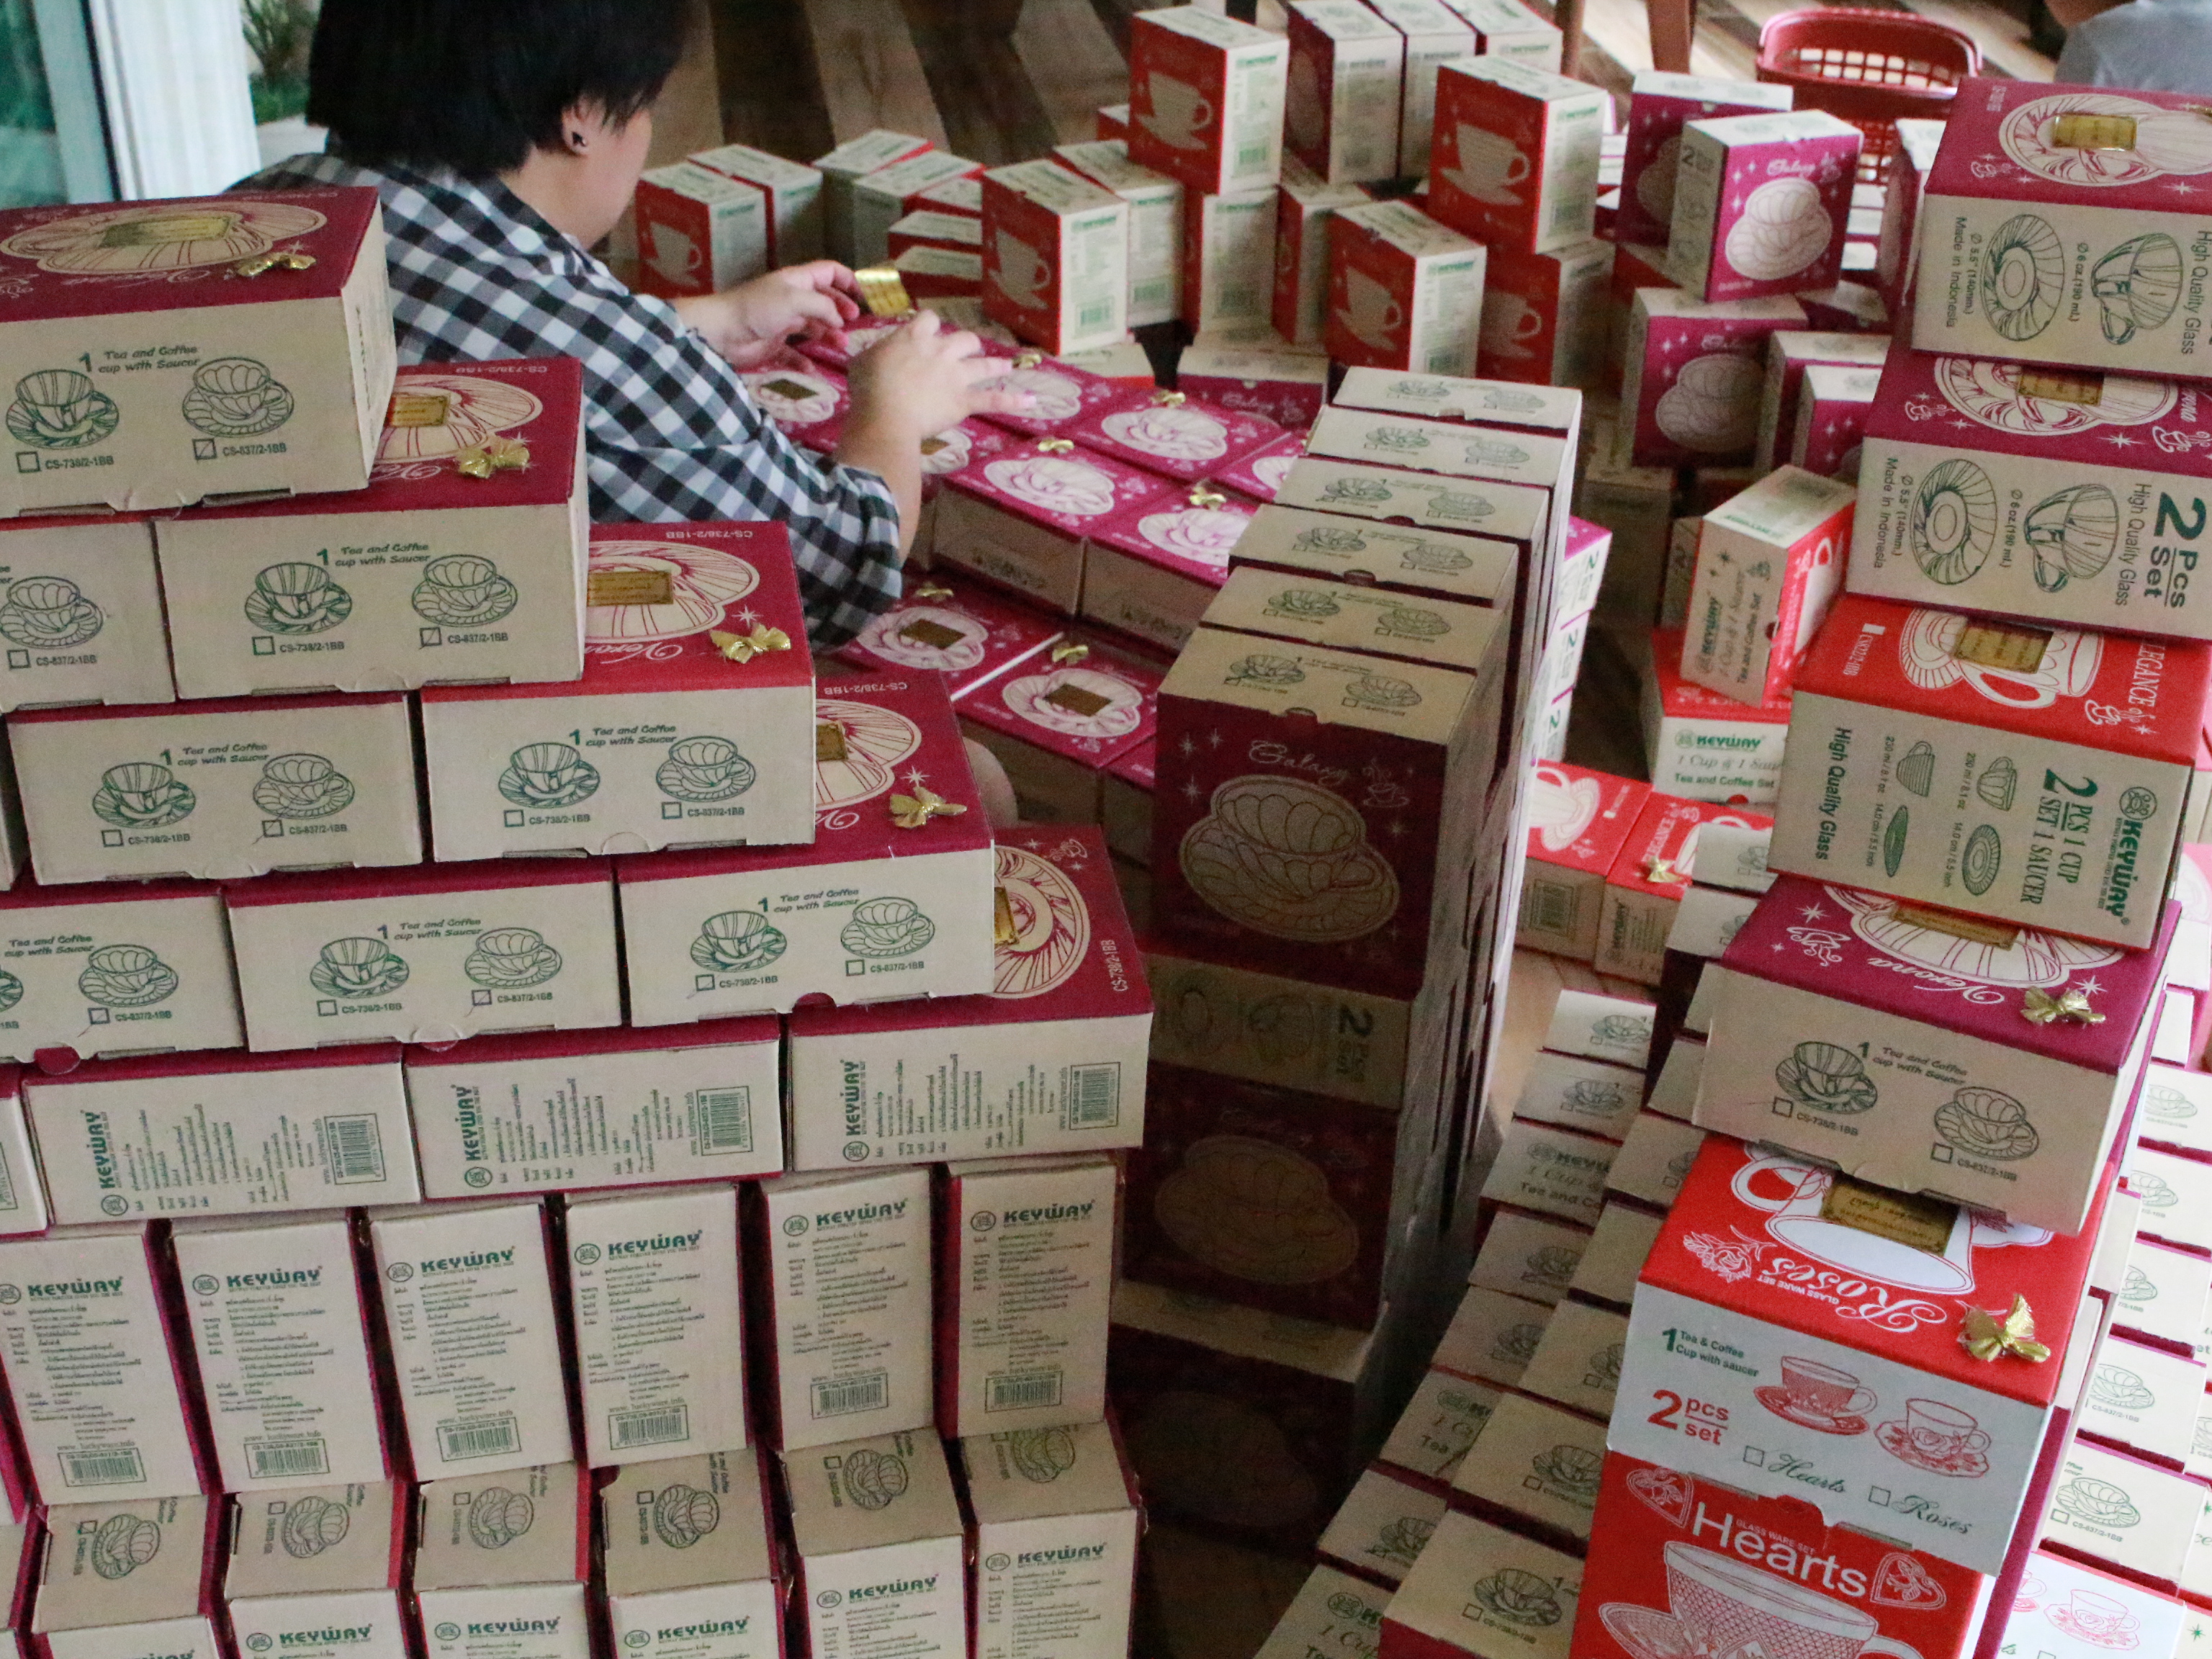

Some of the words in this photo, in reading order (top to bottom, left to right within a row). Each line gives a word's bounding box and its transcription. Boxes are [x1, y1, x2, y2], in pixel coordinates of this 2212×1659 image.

[1953, 217, 1967, 251] Made
[2190, 230, 2212, 261] High
[1953, 256, 1961, 266] in
[1946, 271, 1959, 328] Indonesia
[2183, 266, 2208, 313] Quality
[2180, 318, 2201, 355] Glass
[79, 353, 92, 372] 1
[104, 350, 127, 360] Tea
[132, 347, 156, 359] and
[158, 345, 198, 356] Coffee
[99, 365, 120, 374] cup
[125, 360, 151, 372] with
[157, 359, 200, 369] Saucer
[1884, 457, 1898, 491] Made
[1881, 496, 1894, 506] in
[2128, 483, 2152, 514] High
[2154, 492, 2206, 541] 2
[1874, 511, 1888, 569] Indonesia
[2119, 518, 2145, 565] Quality
[317, 548, 329, 566] 1
[341, 547, 364, 555] Tea
[367, 544, 390, 554] and
[392, 543, 429, 552] Coffee
[335, 559, 356, 567] cup
[359, 556, 386, 565] with
[390, 554, 431, 564] Saucer
[2144, 545, 2171, 598] Set
[2170, 549, 2198, 609] Pcs
[2115, 569, 2136, 606] Glass
[585, 641, 683, 663] Vero
[2128, 639, 2165, 707] LEGANCE
[569, 729, 580, 745] 1
[617, 726, 638, 734] and
[641, 725, 676, 734] Coffee
[585, 738, 606, 747] cup
[609, 737, 634, 745] with
[637, 735, 676, 744] Saucer
[1828, 727, 1853, 762] High
[161, 750, 172, 765] 1
[183, 747, 203, 755] Tea
[208, 745, 229, 753] and
[232, 743, 267, 752] Coffee
[201, 755, 226, 764] with
[230, 753, 269, 762] Saucer
[1818, 765, 1844, 817] Quality
[2044, 768, 2098, 797] 2
[2036, 796, 2062, 828] SET
[2067, 803, 2092, 833] PCS
[1815, 820, 1837, 860] Glass
[2033, 831, 2054, 840] 1
[2064, 837, 2086, 846] 1
[2020, 843, 2052, 905] SAUCER
[2057, 852, 2082, 884] CUP
[758, 898, 769, 912] 1
[803, 891, 824, 900] and
[826, 889, 860, 899] Coffee
[796, 902, 819, 910] with
[823, 898, 860, 908] Saucer
[9, 939, 30, 948] Tea
[34, 937, 55, 945] and
[58, 935, 93, 944] Coffee
[377, 925, 388, 939] 1
[424, 920, 444, 928] and
[447, 918, 481, 927] Coffee
[395, 932, 413, 941] cup
[417, 930, 441, 938] with
[446, 928, 482, 937] Saucer
[28, 947, 53, 956] with
[55, 945, 94, 954] Saucer
[1859, 1042, 1870, 1058] 1
[840, 1059, 860, 1136] KEYWAY
[451, 1084, 482, 1161] KEYWAY
[82, 1110, 115, 1189] KEYWAY
[817, 1197, 907, 1225] KEYWAY
[1004, 1199, 1095, 1223] KEYWAY
[608, 1230, 703, 1255] KEYWAY
[421, 1246, 515, 1273] KEYWAY
[28, 1277, 123, 1296] KEYWAY
[226, 1266, 322, 1287] KEYWAY
[1758, 1273, 1776, 1286] SET
[1777, 1280, 1805, 1295] WARE
[1762, 1257, 1948, 1332] Roses
[1807, 1288, 1840, 1305] GLASS
[1662, 1328, 1678, 1352] 1
[1681, 1330, 1698, 1344] Tea
[1699, 1337, 1709, 1347] &
[1710, 1339, 1745, 1359] Coffee
[1676, 1344, 1696, 1359] Cup
[1697, 1351, 1718, 1366] with
[1719, 1359, 1759, 1377] saucer
[1647, 1389, 1685, 1431] 2
[1686, 1395, 1730, 1421] pcs
[1685, 1426, 1722, 1446] set
[1768, 1452, 1846, 1493] Hearts
[1891, 1495, 1973, 1534] Roses
[1735, 1519, 1766, 1537] GLASS
[1767, 1529, 1796, 1547] WARE
[1017, 1542, 1107, 1563] KEYWAY
[1691, 1501, 1868, 1598] Hearts
[849, 1573, 939, 1599] KEYWAY
[279, 1624, 372, 1643] KEYWAY
[467, 1617, 560, 1635] KEYWAY
[657, 1616, 750, 1640] KEYWAY
